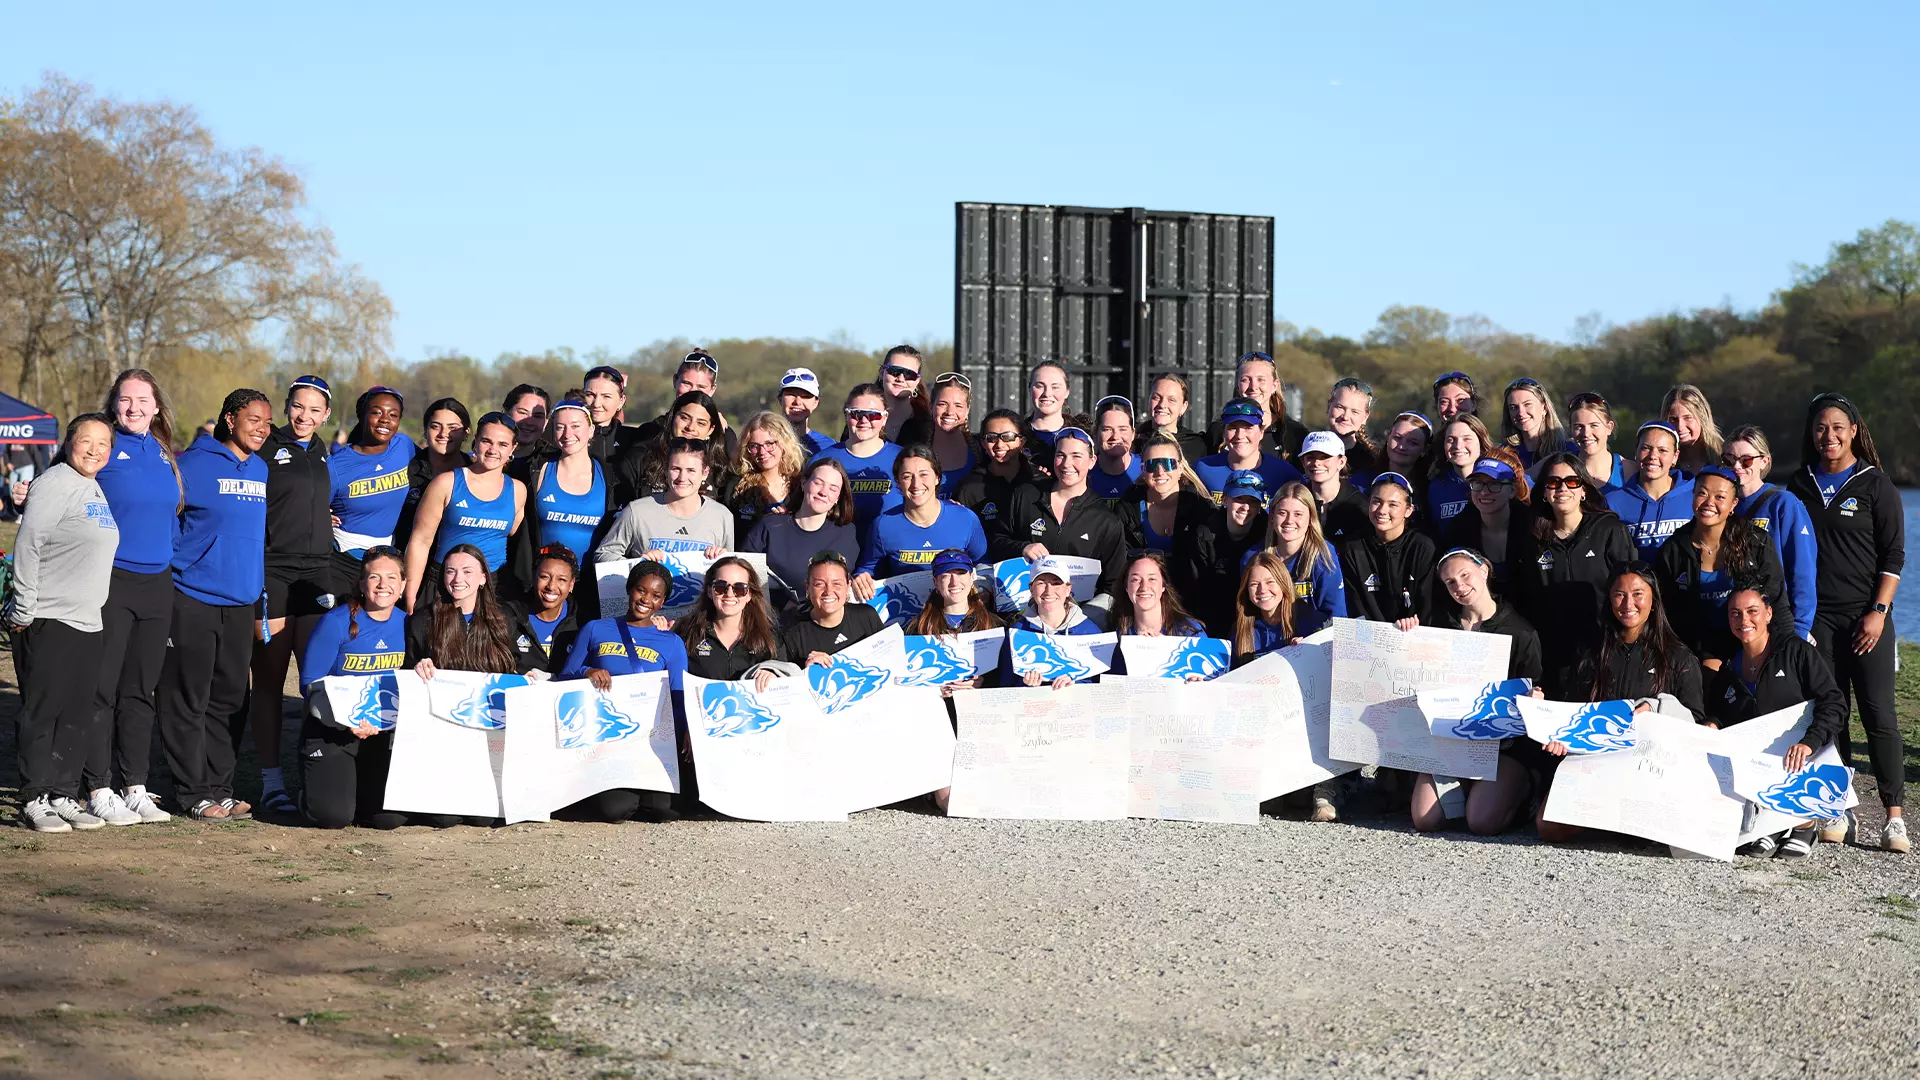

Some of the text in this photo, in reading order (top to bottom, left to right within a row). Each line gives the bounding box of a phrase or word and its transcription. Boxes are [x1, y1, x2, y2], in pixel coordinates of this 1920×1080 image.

[852, 480, 888, 493] AWARE
[458, 516, 508, 531] DELAWARE
[547, 511, 601, 526] DELAWARE
[599, 644, 658, 661] DELAARE
